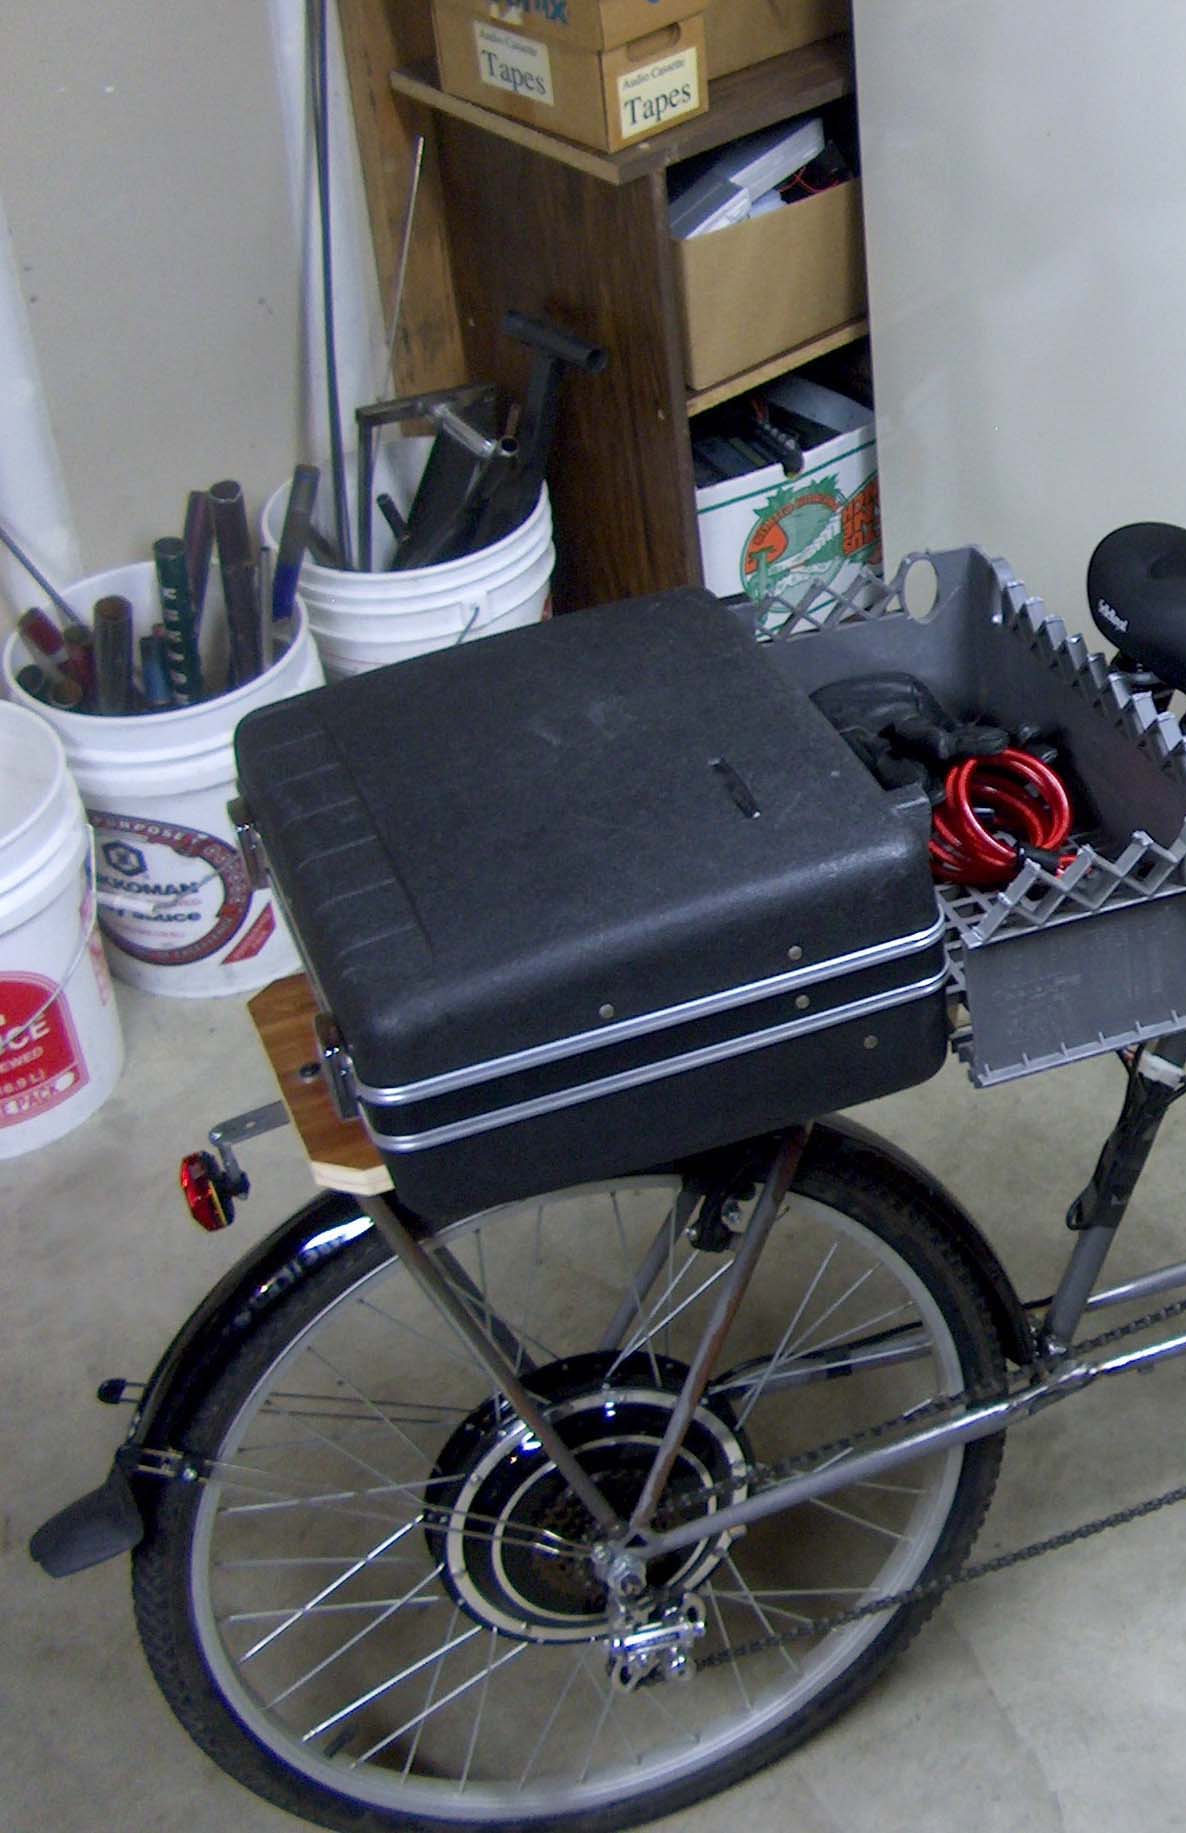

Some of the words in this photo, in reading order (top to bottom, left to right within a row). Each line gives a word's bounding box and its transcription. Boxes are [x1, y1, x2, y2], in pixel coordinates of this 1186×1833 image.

[481, 48, 547, 96] Tapes
[622, 73, 650, 90] Audio
[623, 83, 692, 124] Tapes
